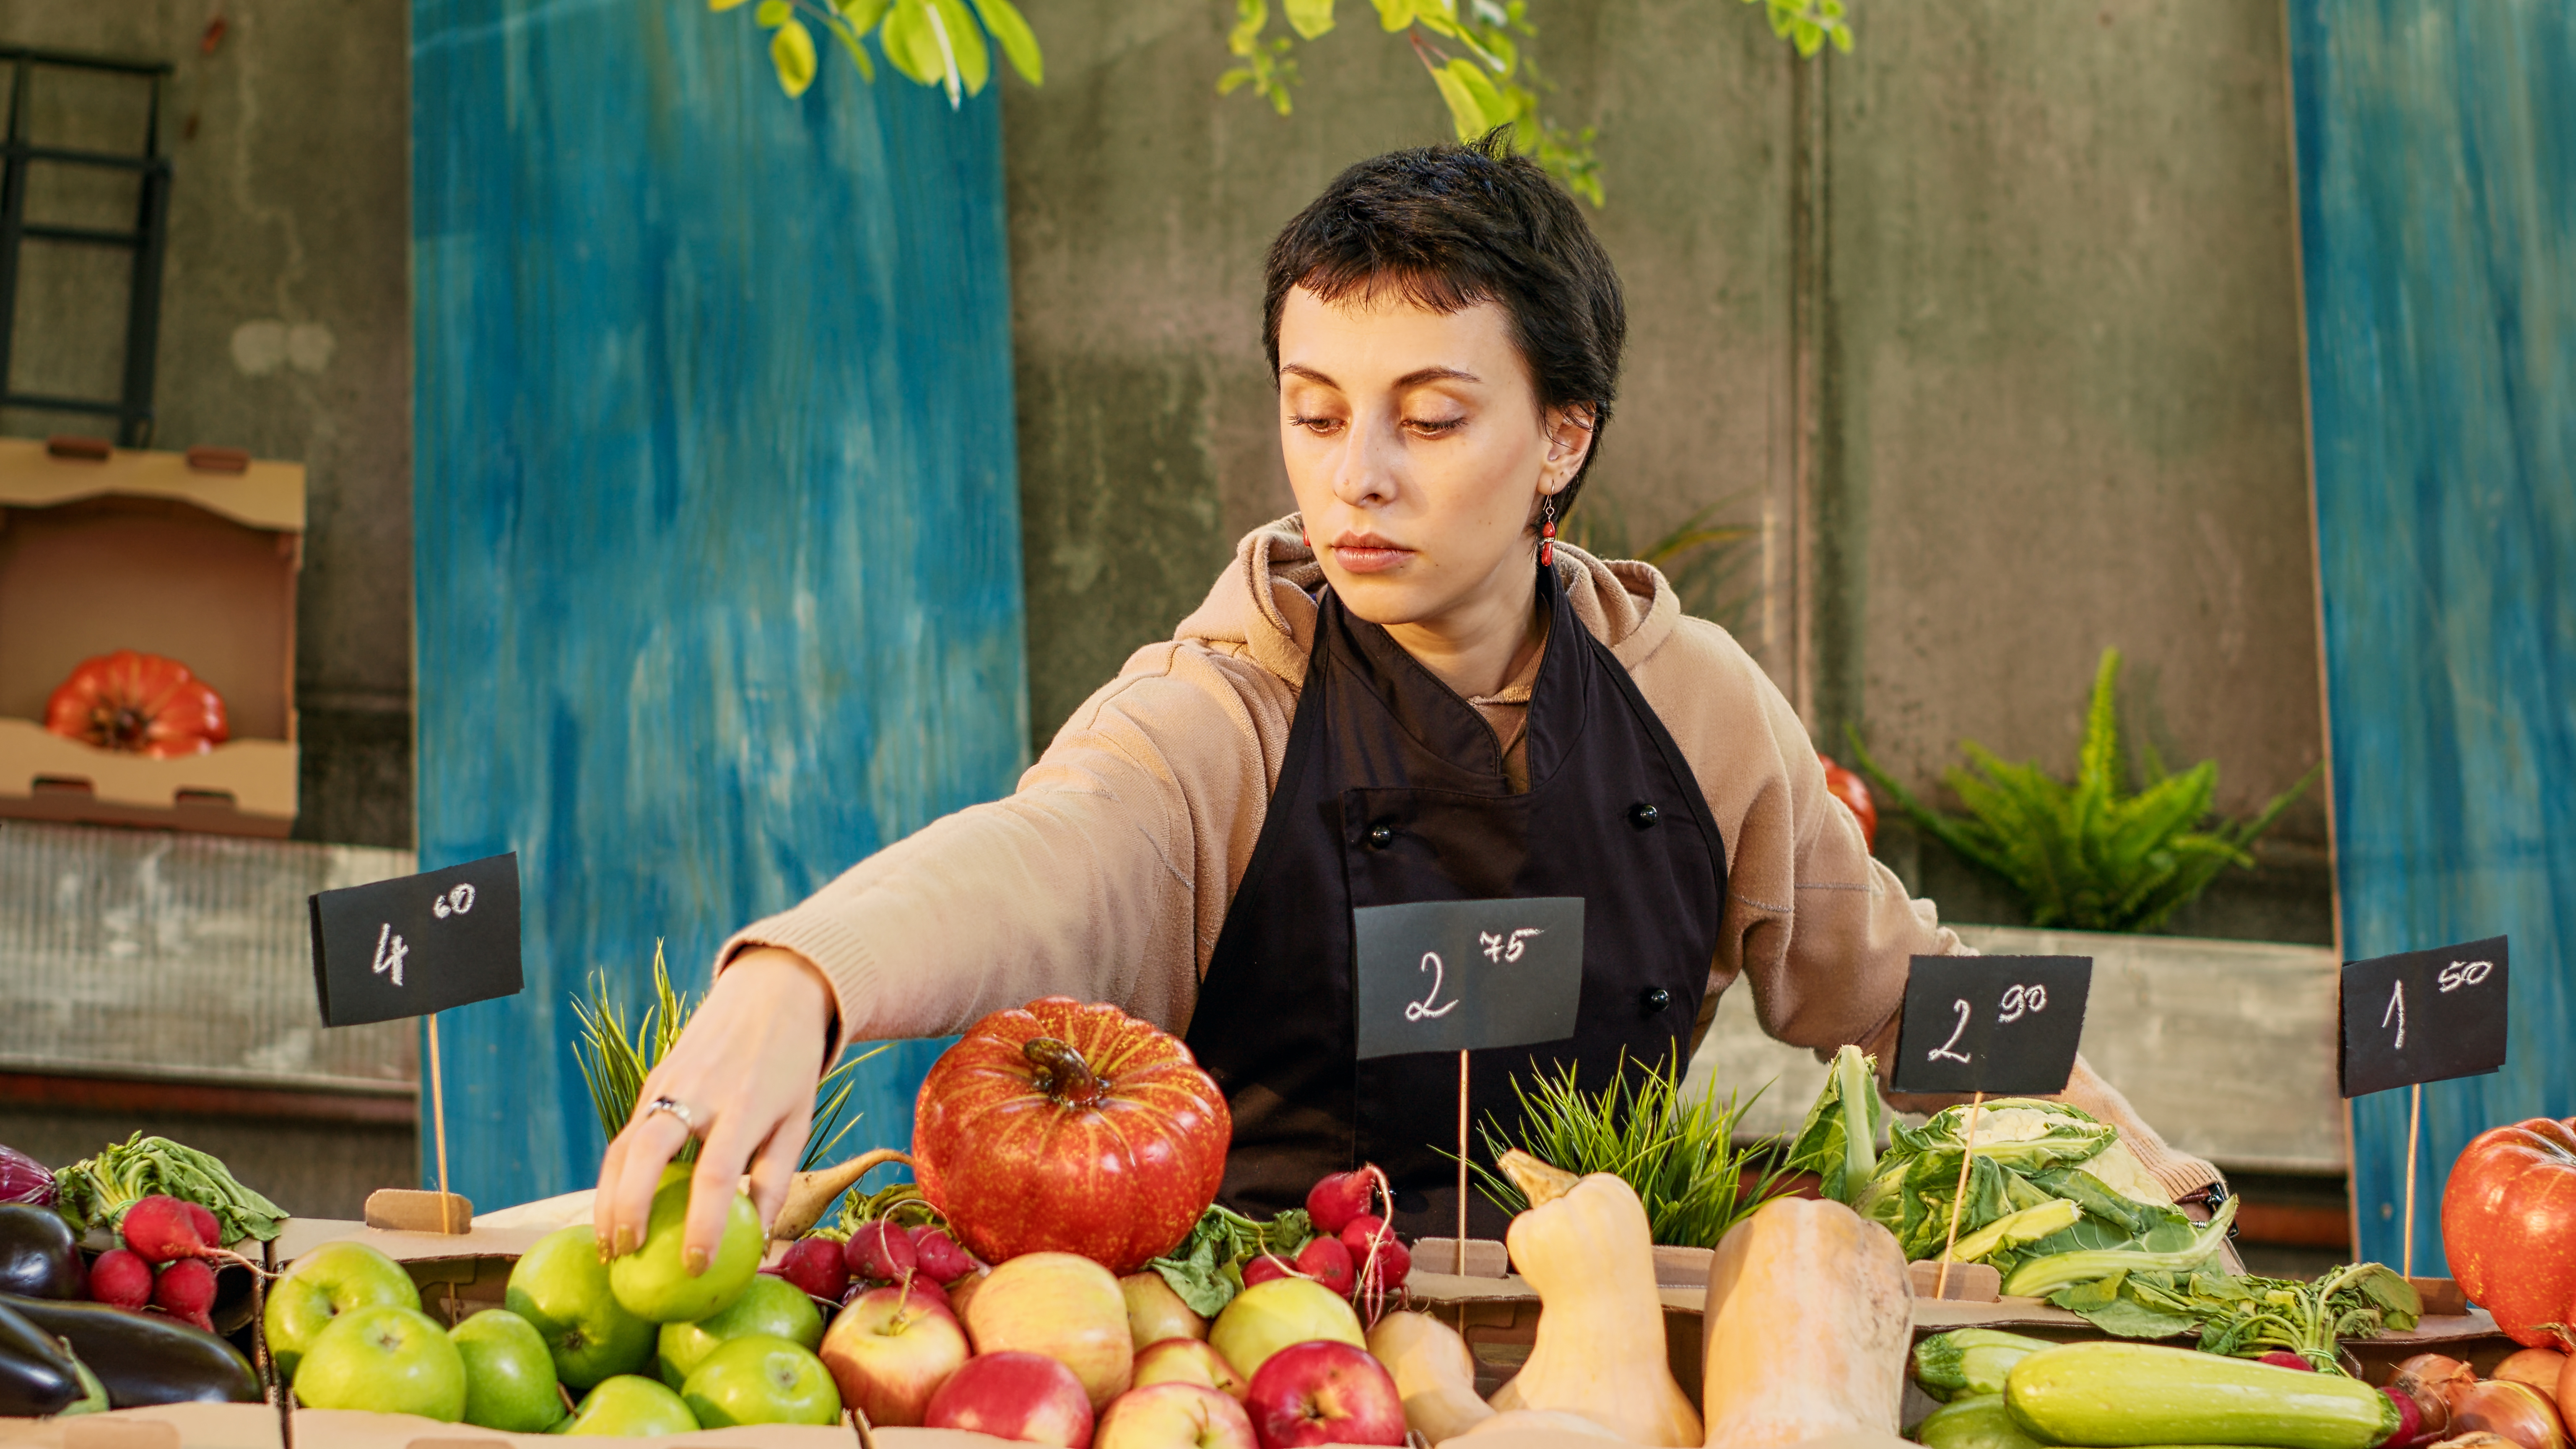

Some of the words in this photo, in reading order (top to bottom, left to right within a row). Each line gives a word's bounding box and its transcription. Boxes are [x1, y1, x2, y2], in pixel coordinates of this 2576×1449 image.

[373, 923, 409, 986] 4
[433, 883, 476, 919] 60
[1405, 951, 1459, 1022] 2
[1479, 928, 1545, 963] 75
[1927, 999, 1971, 1064] 2
[1997, 984, 2047, 1023] 90
[2381, 979, 2405, 1049] 1
[2438, 961, 2493, 993] 50
